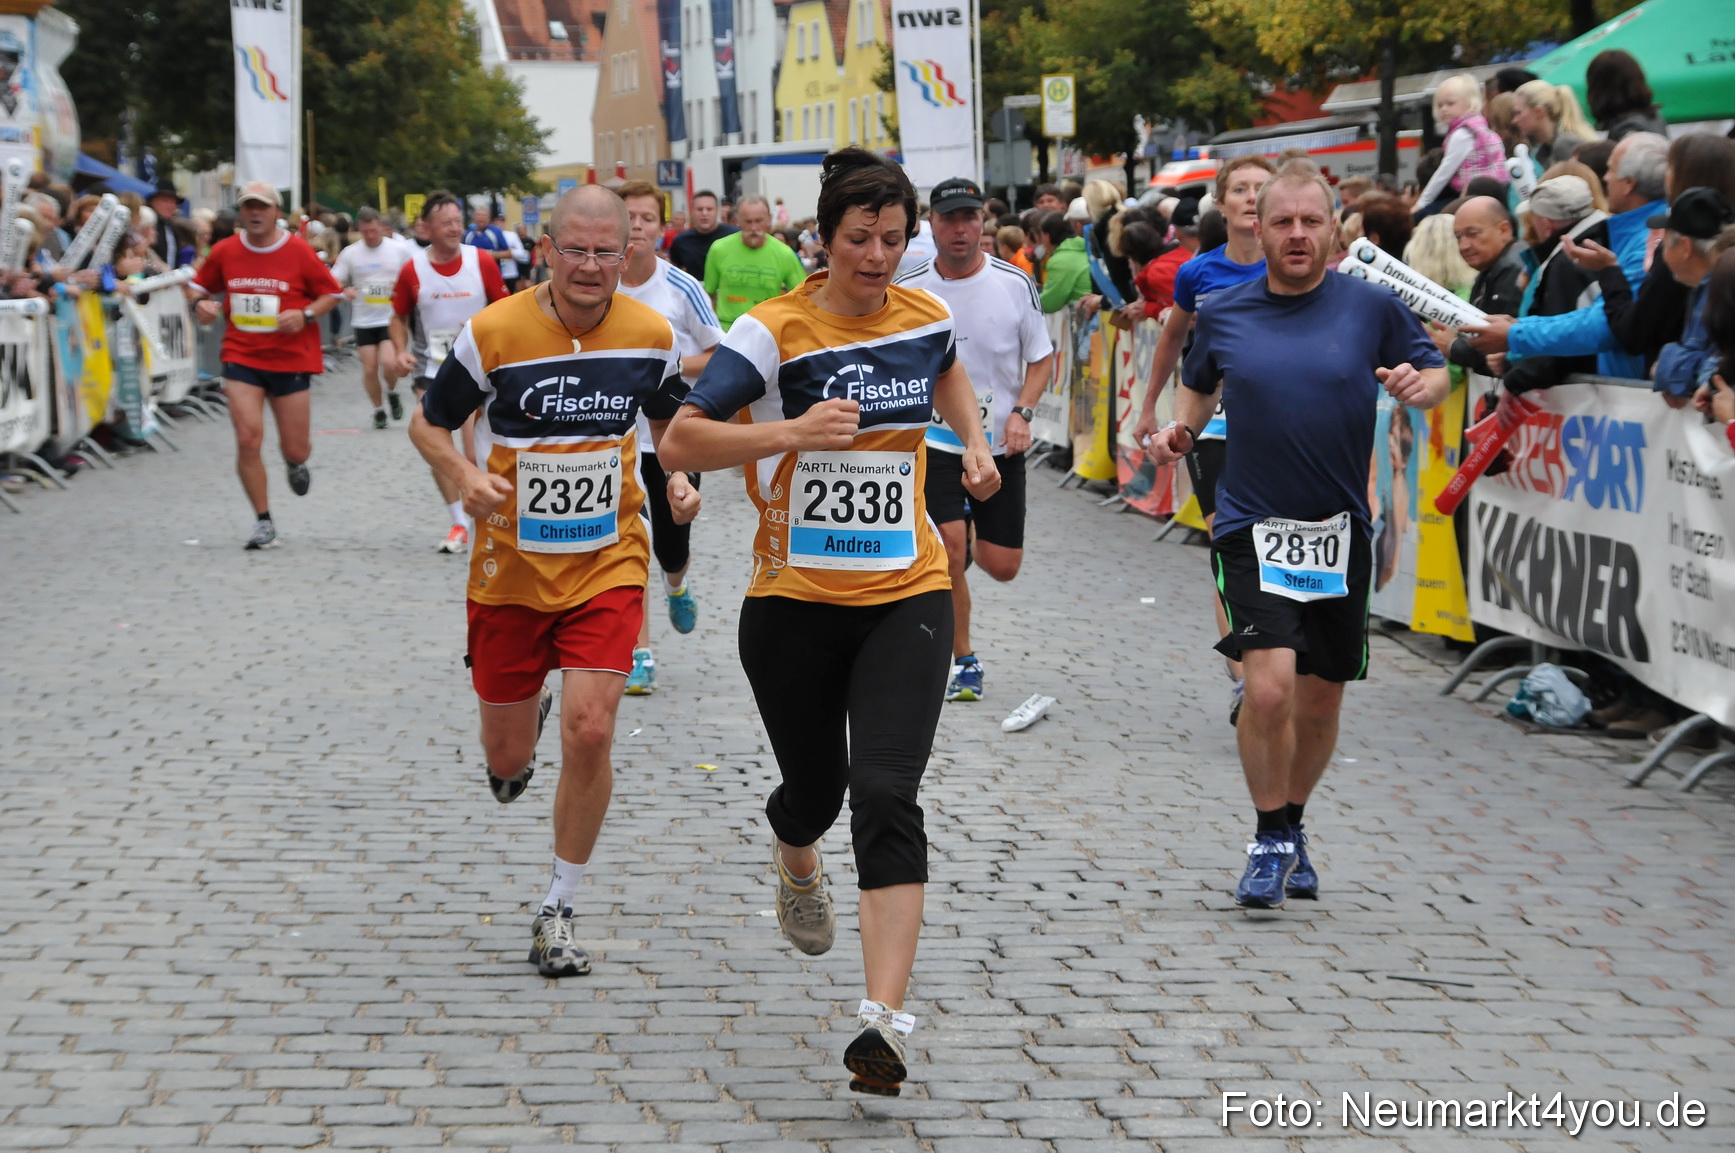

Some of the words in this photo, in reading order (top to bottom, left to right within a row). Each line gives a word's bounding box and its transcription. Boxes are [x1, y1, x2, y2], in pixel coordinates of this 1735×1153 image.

[227, 277, 280, 289] NEUMARKT
[242, 296, 263, 313] 18
[846, 377, 929, 401] Fischer
[541, 390, 633, 414] Fischer
[859, 395, 929, 412] AUTOMOBILE
[552, 412, 628, 423] AUTOMOBILE
[519, 460, 554, 474] PARTL
[557, 460, 607, 474] Neumarkt
[796, 461, 837, 474] PARTL
[840, 462, 896, 475] Neumarkt
[528, 473, 614, 515] 2324
[803, 479, 903, 525] 2338
[540, 523, 602, 539] Christian
[1256, 520, 1291, 532] PARTL
[1293, 522, 1338, 533] Neumarkt
[824, 535, 881, 554] Andrea
[1264, 532, 1340, 568] 2810
[1284, 573, 1324, 590] Stefan
